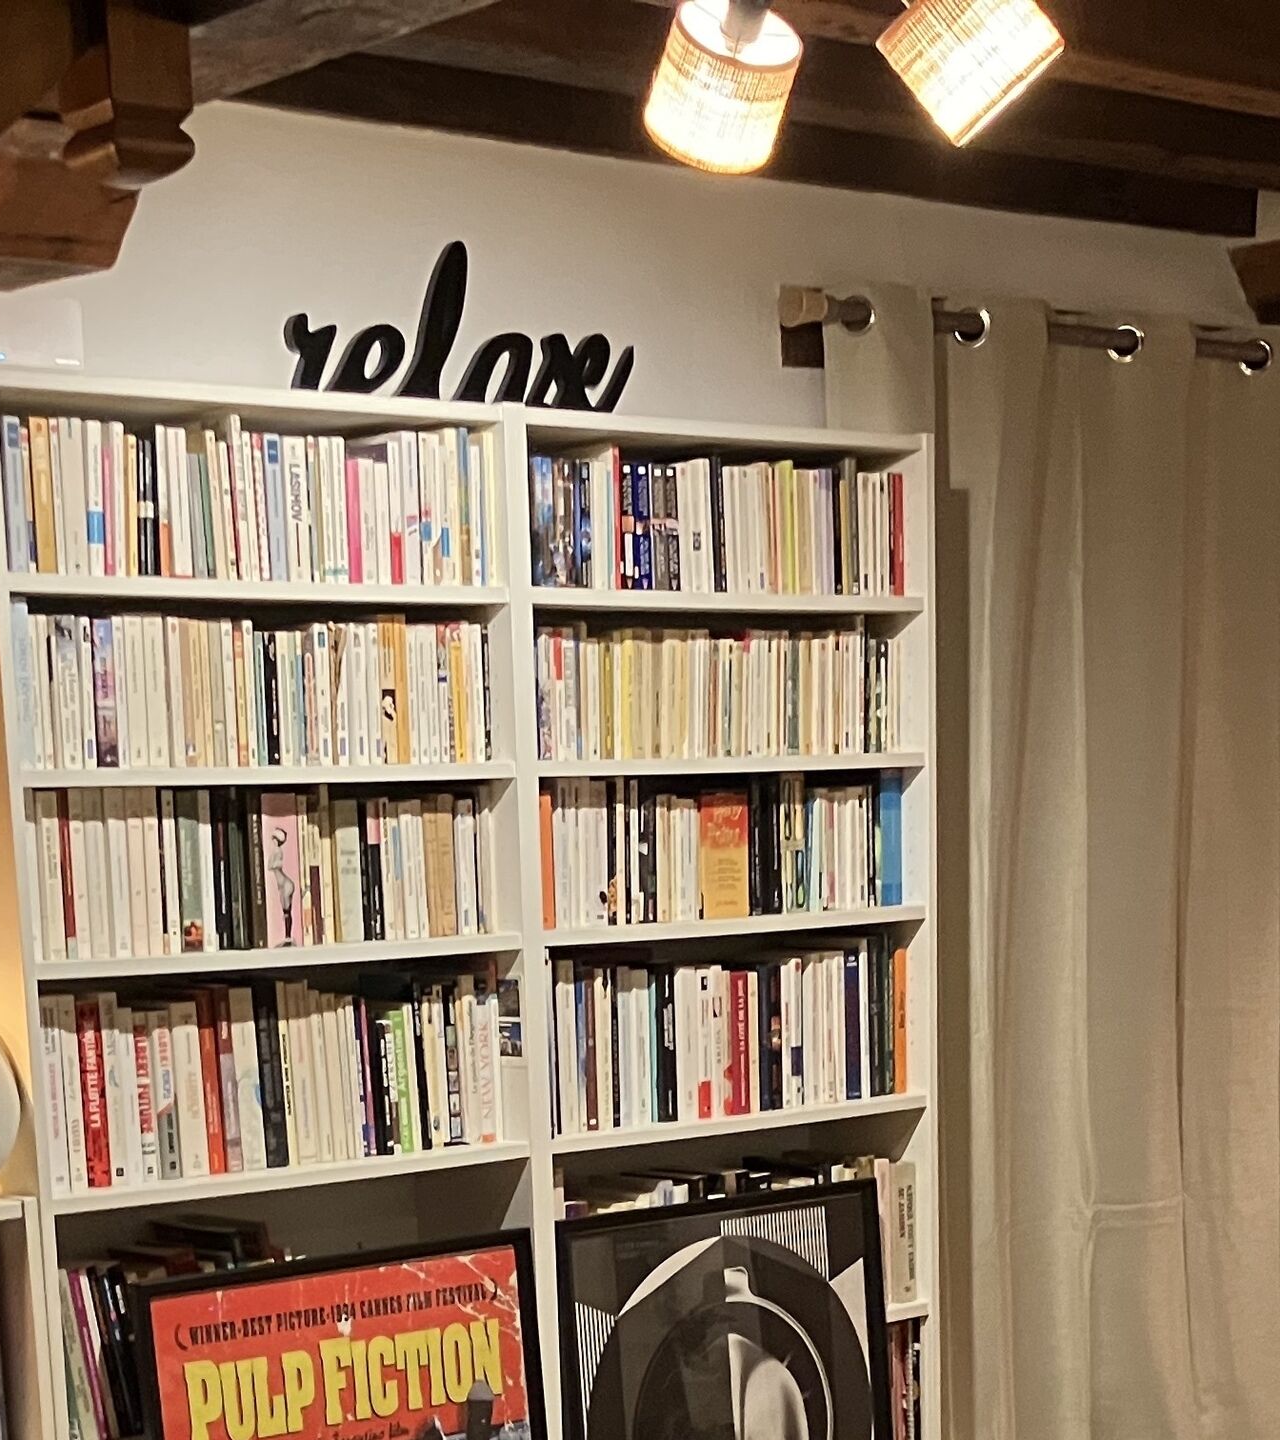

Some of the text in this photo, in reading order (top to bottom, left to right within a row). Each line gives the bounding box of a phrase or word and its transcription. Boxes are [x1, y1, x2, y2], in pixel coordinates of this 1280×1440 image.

[478, 1021, 492, 1120] NEW YORK
[359, 1295, 403, 1319] CANNES
[406, 1289, 433, 1312] FILM
[318, 1317, 503, 1427] FICTION
